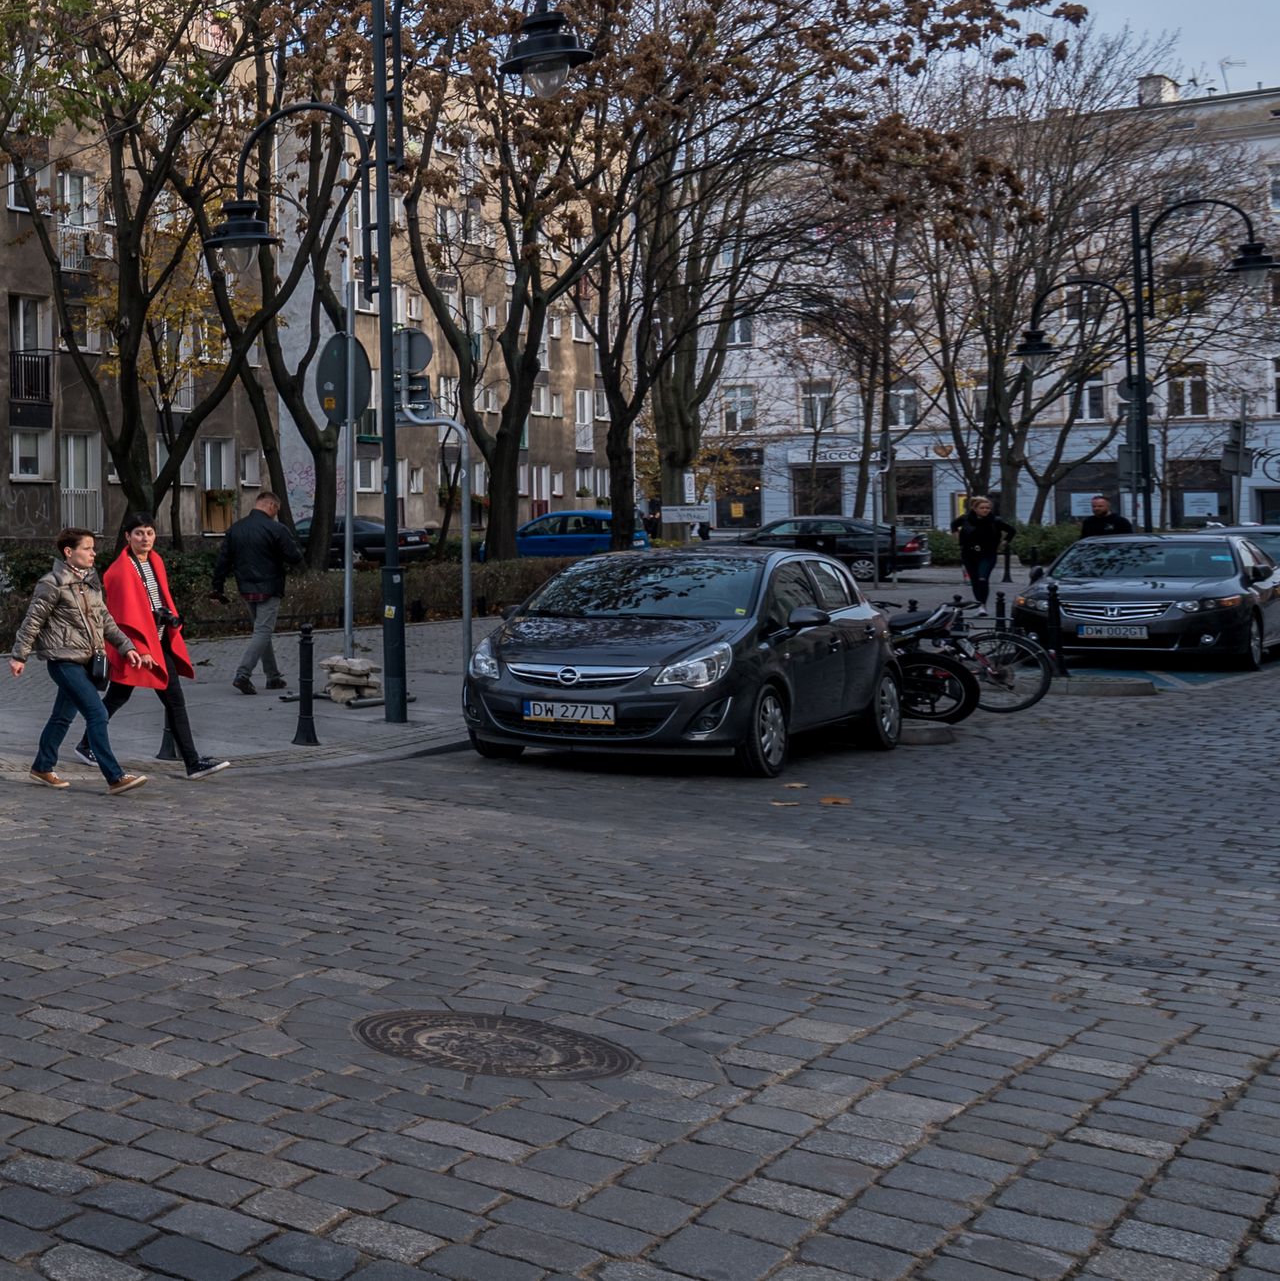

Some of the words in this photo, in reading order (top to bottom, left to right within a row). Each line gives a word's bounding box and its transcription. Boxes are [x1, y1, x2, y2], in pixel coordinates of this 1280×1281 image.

[1085, 627, 1103, 635] DW
[1107, 627, 1145, 636] 002GT
[532, 703, 554, 717] DW
[560, 704, 611, 720] 277LX
